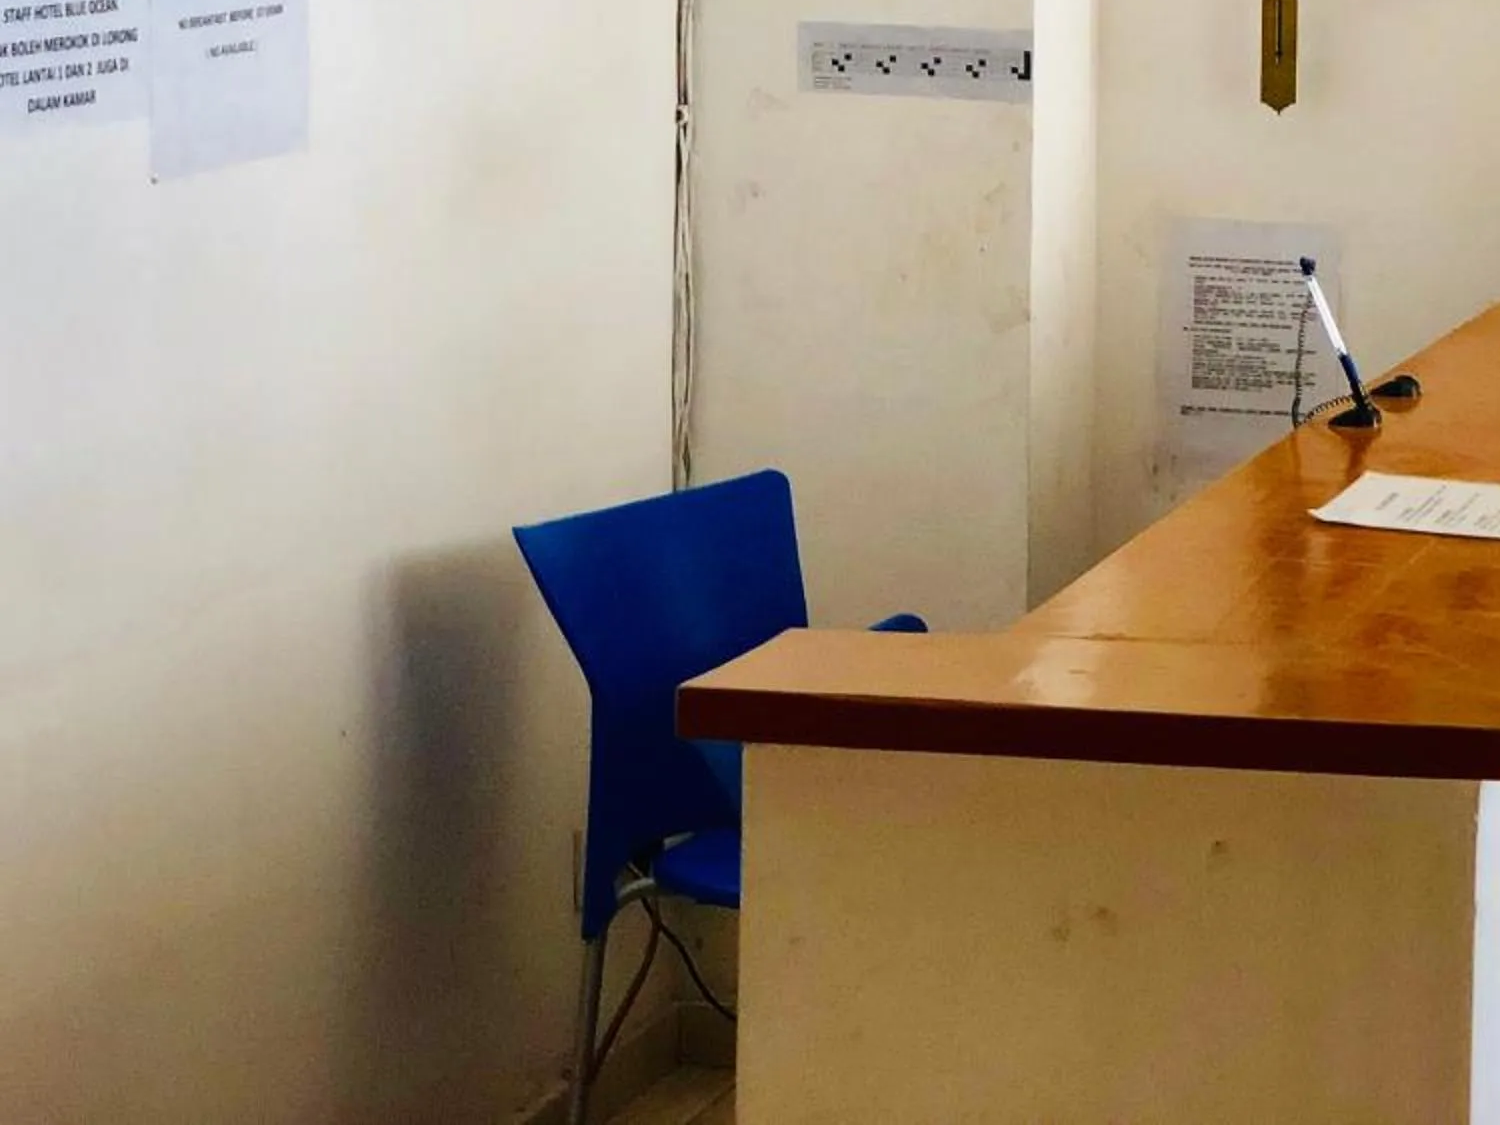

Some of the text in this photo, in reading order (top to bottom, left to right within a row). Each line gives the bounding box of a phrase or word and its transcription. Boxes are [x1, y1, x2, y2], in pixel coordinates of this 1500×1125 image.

[3, 6, 32, 24] STAFF
[33, 2, 63, 19] HOTEL
[65, 0, 87, 17] BLUE
[11, 39, 42, 57] BOLEH
[43, 33, 89, 52] MEROKOK
[102, 27, 138, 46] LORONG
[65, 62, 85, 80] DAN
[28, 89, 96, 113] DALAM KAMAR
